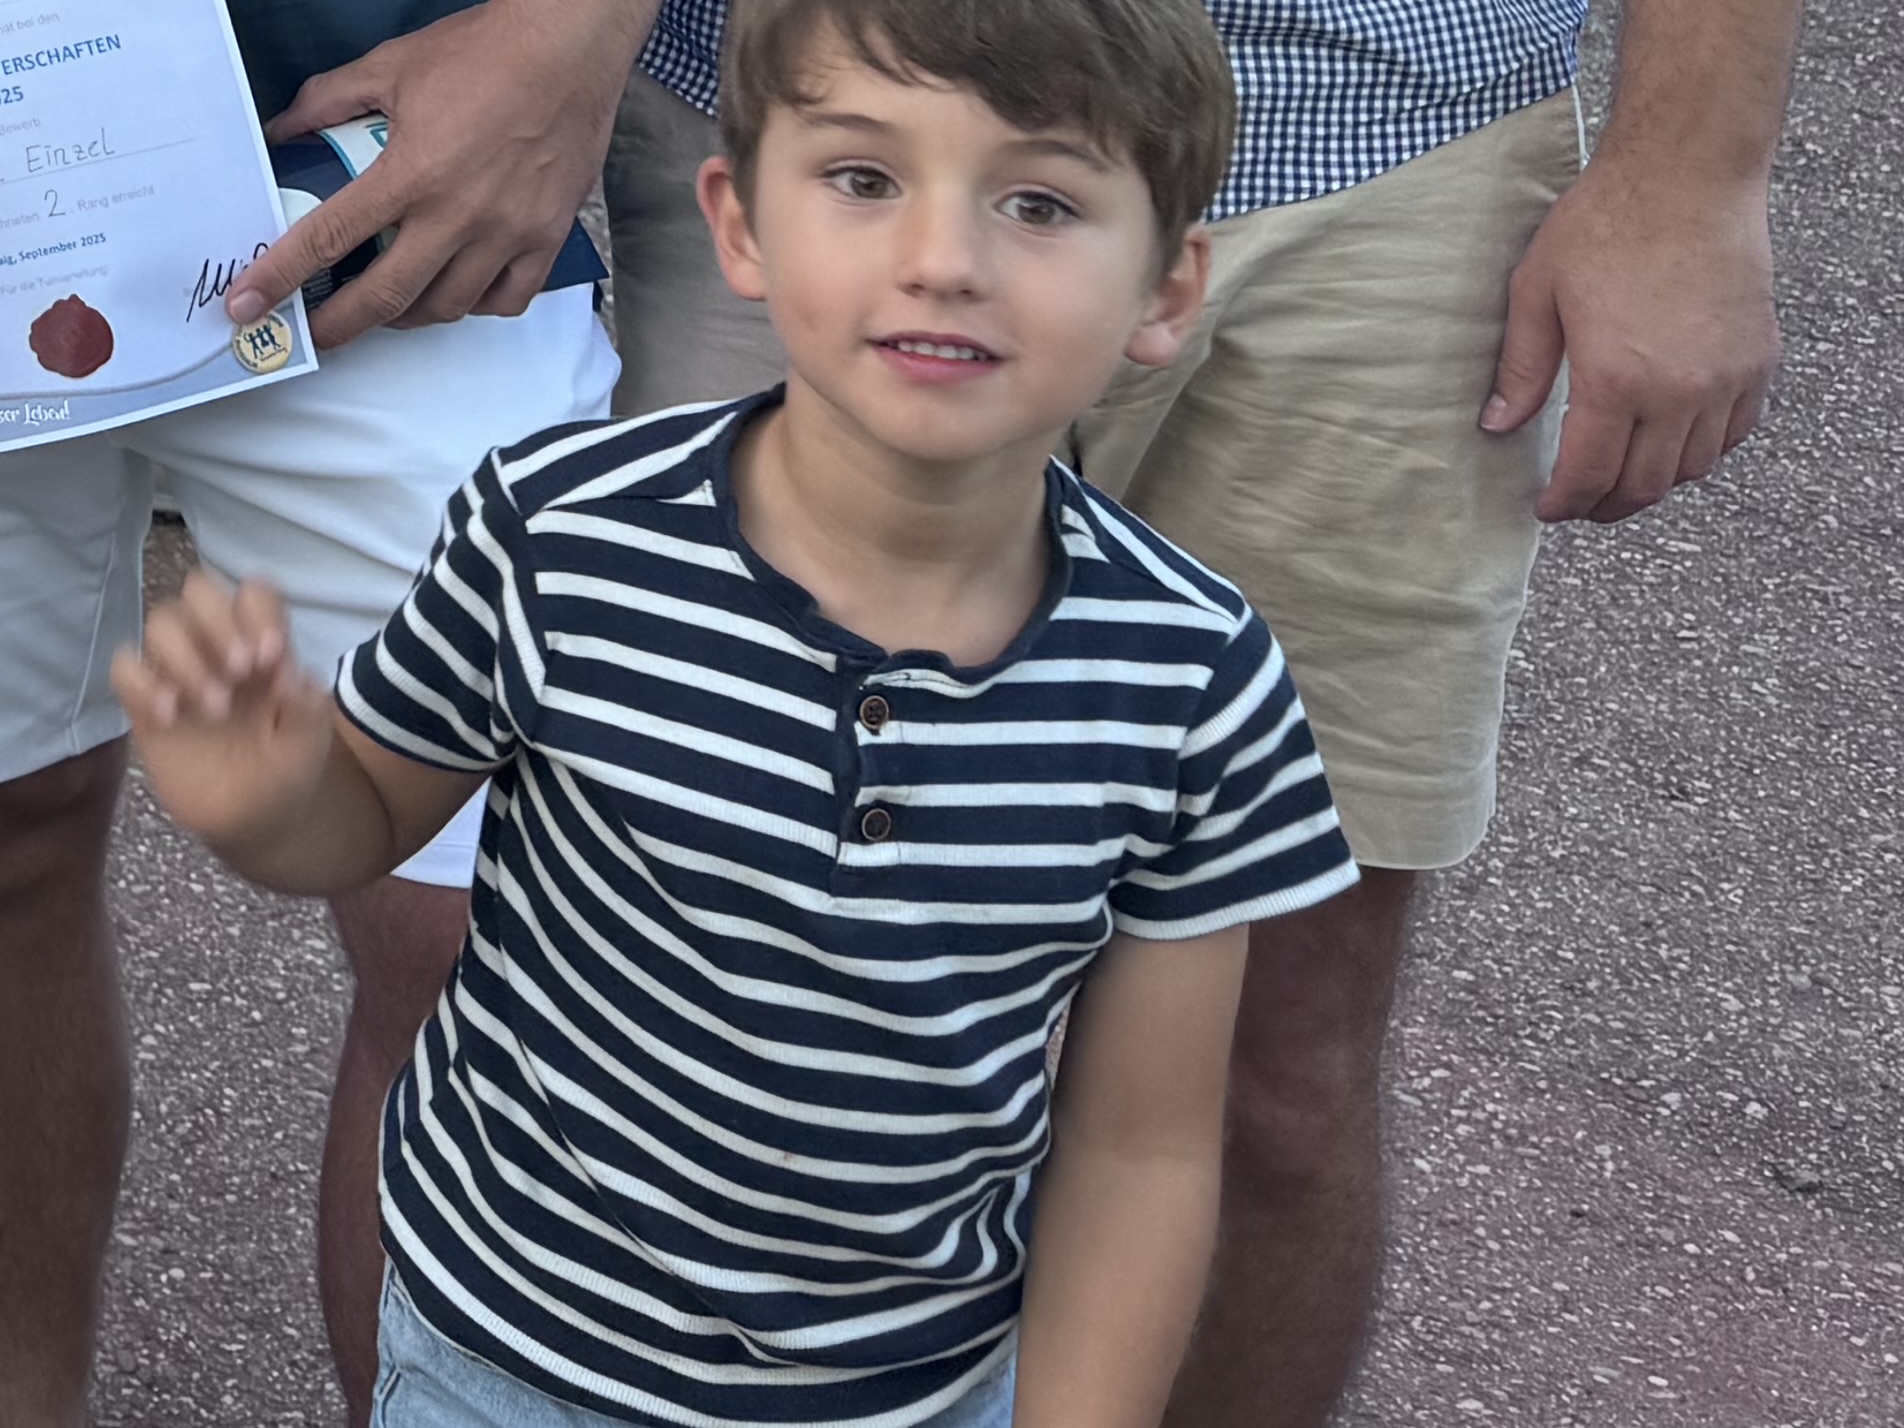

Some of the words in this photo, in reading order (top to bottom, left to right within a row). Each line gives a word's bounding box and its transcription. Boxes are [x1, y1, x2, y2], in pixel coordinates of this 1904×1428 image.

[37, 12, 60, 26] den
[25, 126, 115, 173] Einzel
[77, 194, 109, 211] Rang
[18, 240, 78, 263] September
[80, 232, 106, 248] 2025
